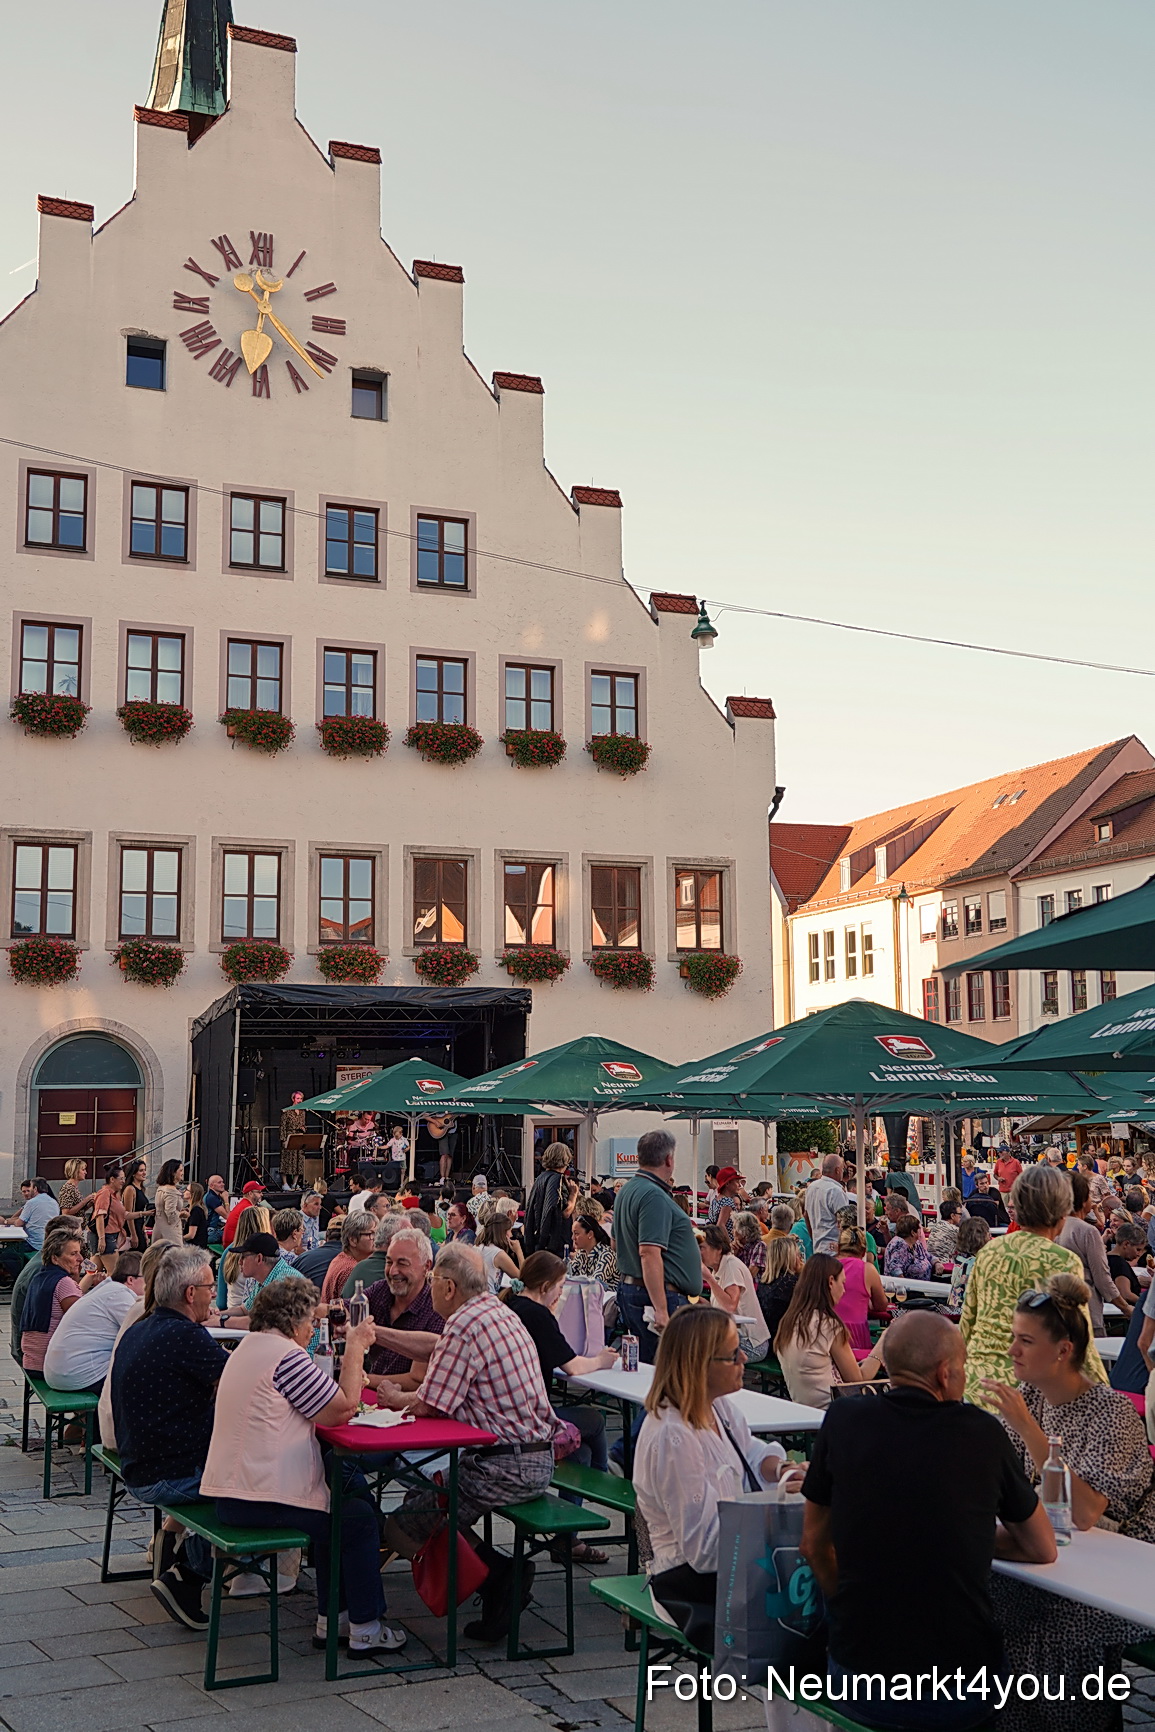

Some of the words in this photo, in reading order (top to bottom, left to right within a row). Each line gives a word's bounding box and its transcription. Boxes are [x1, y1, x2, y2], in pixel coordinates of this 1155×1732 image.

[210, 234, 244, 272] XI
[249, 230, 274, 268] XII
[183, 256, 221, 288] X
[285, 250, 307, 278] I
[173, 290, 210, 315] IX
[303, 281, 338, 302] II
[311, 314, 347, 336] III
[178, 319, 223, 360] VIII
[208, 347, 243, 388] VII
[285, 359, 310, 394] V
[1127, 1008, 1155, 1019] Neu
[1089, 1017, 1155, 1038] Lamm
[869, 1071, 998, 1083] Lammsbräu
[593, 1087, 628, 1095] Lam
[616, 1152, 639, 1162] Kuns
